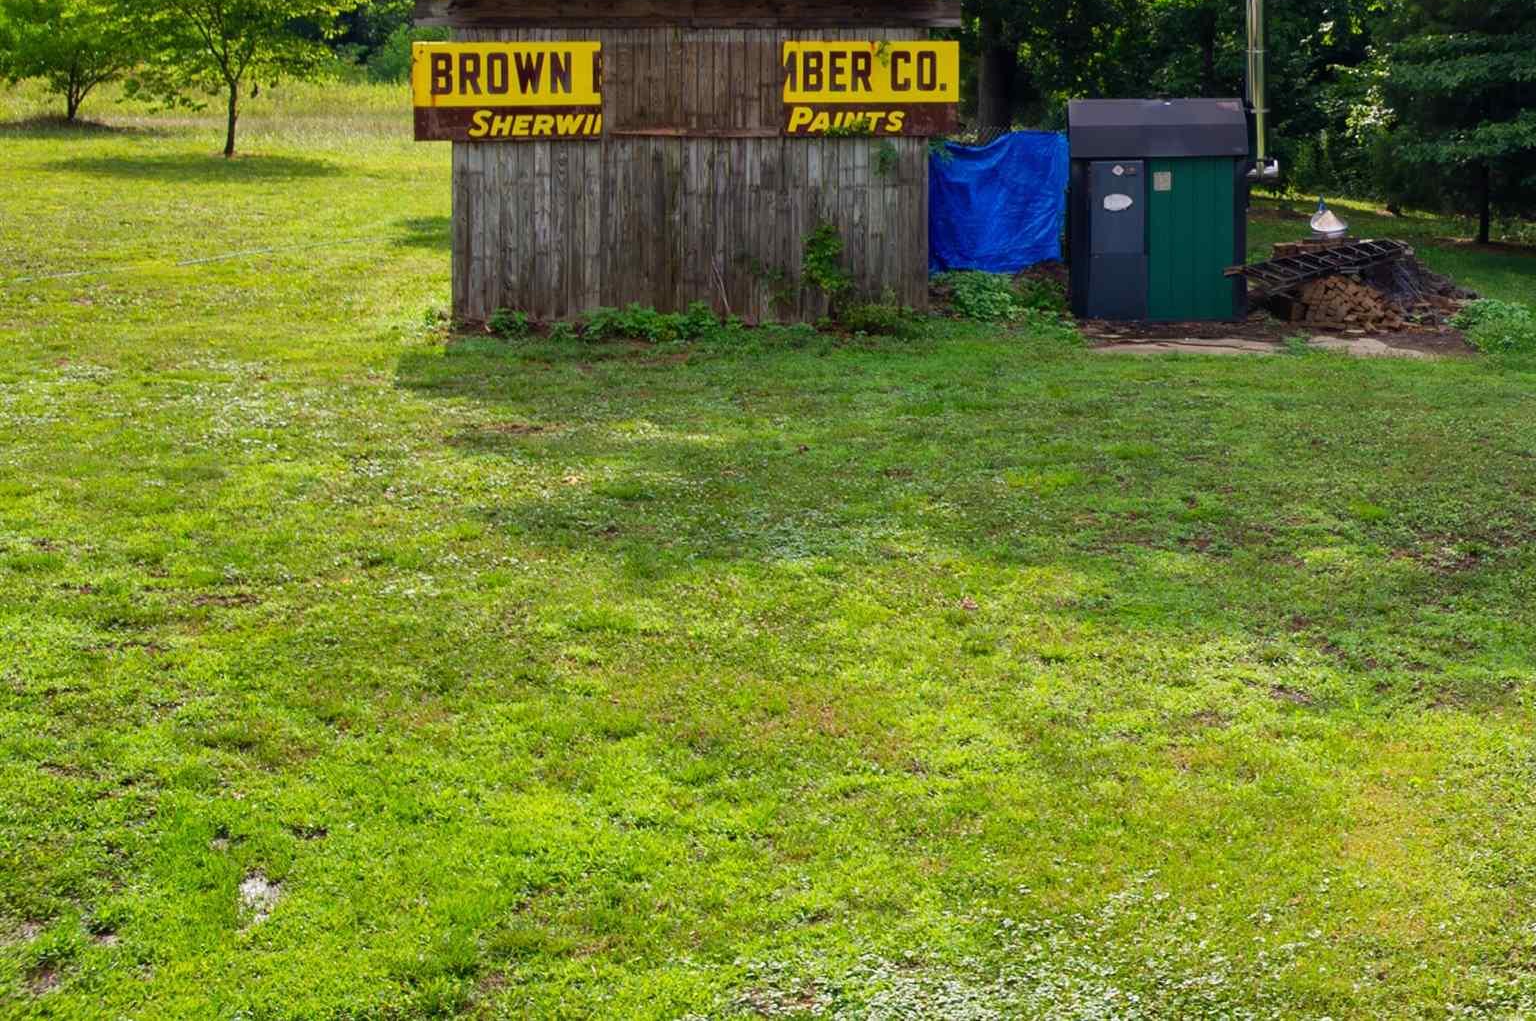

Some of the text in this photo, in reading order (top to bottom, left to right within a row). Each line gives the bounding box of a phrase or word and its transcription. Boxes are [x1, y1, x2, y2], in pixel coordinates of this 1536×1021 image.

[430, 51, 572, 95] BROWN
[890, 50, 947, 92] CO.
[787, 105, 906, 133] PAINTS
